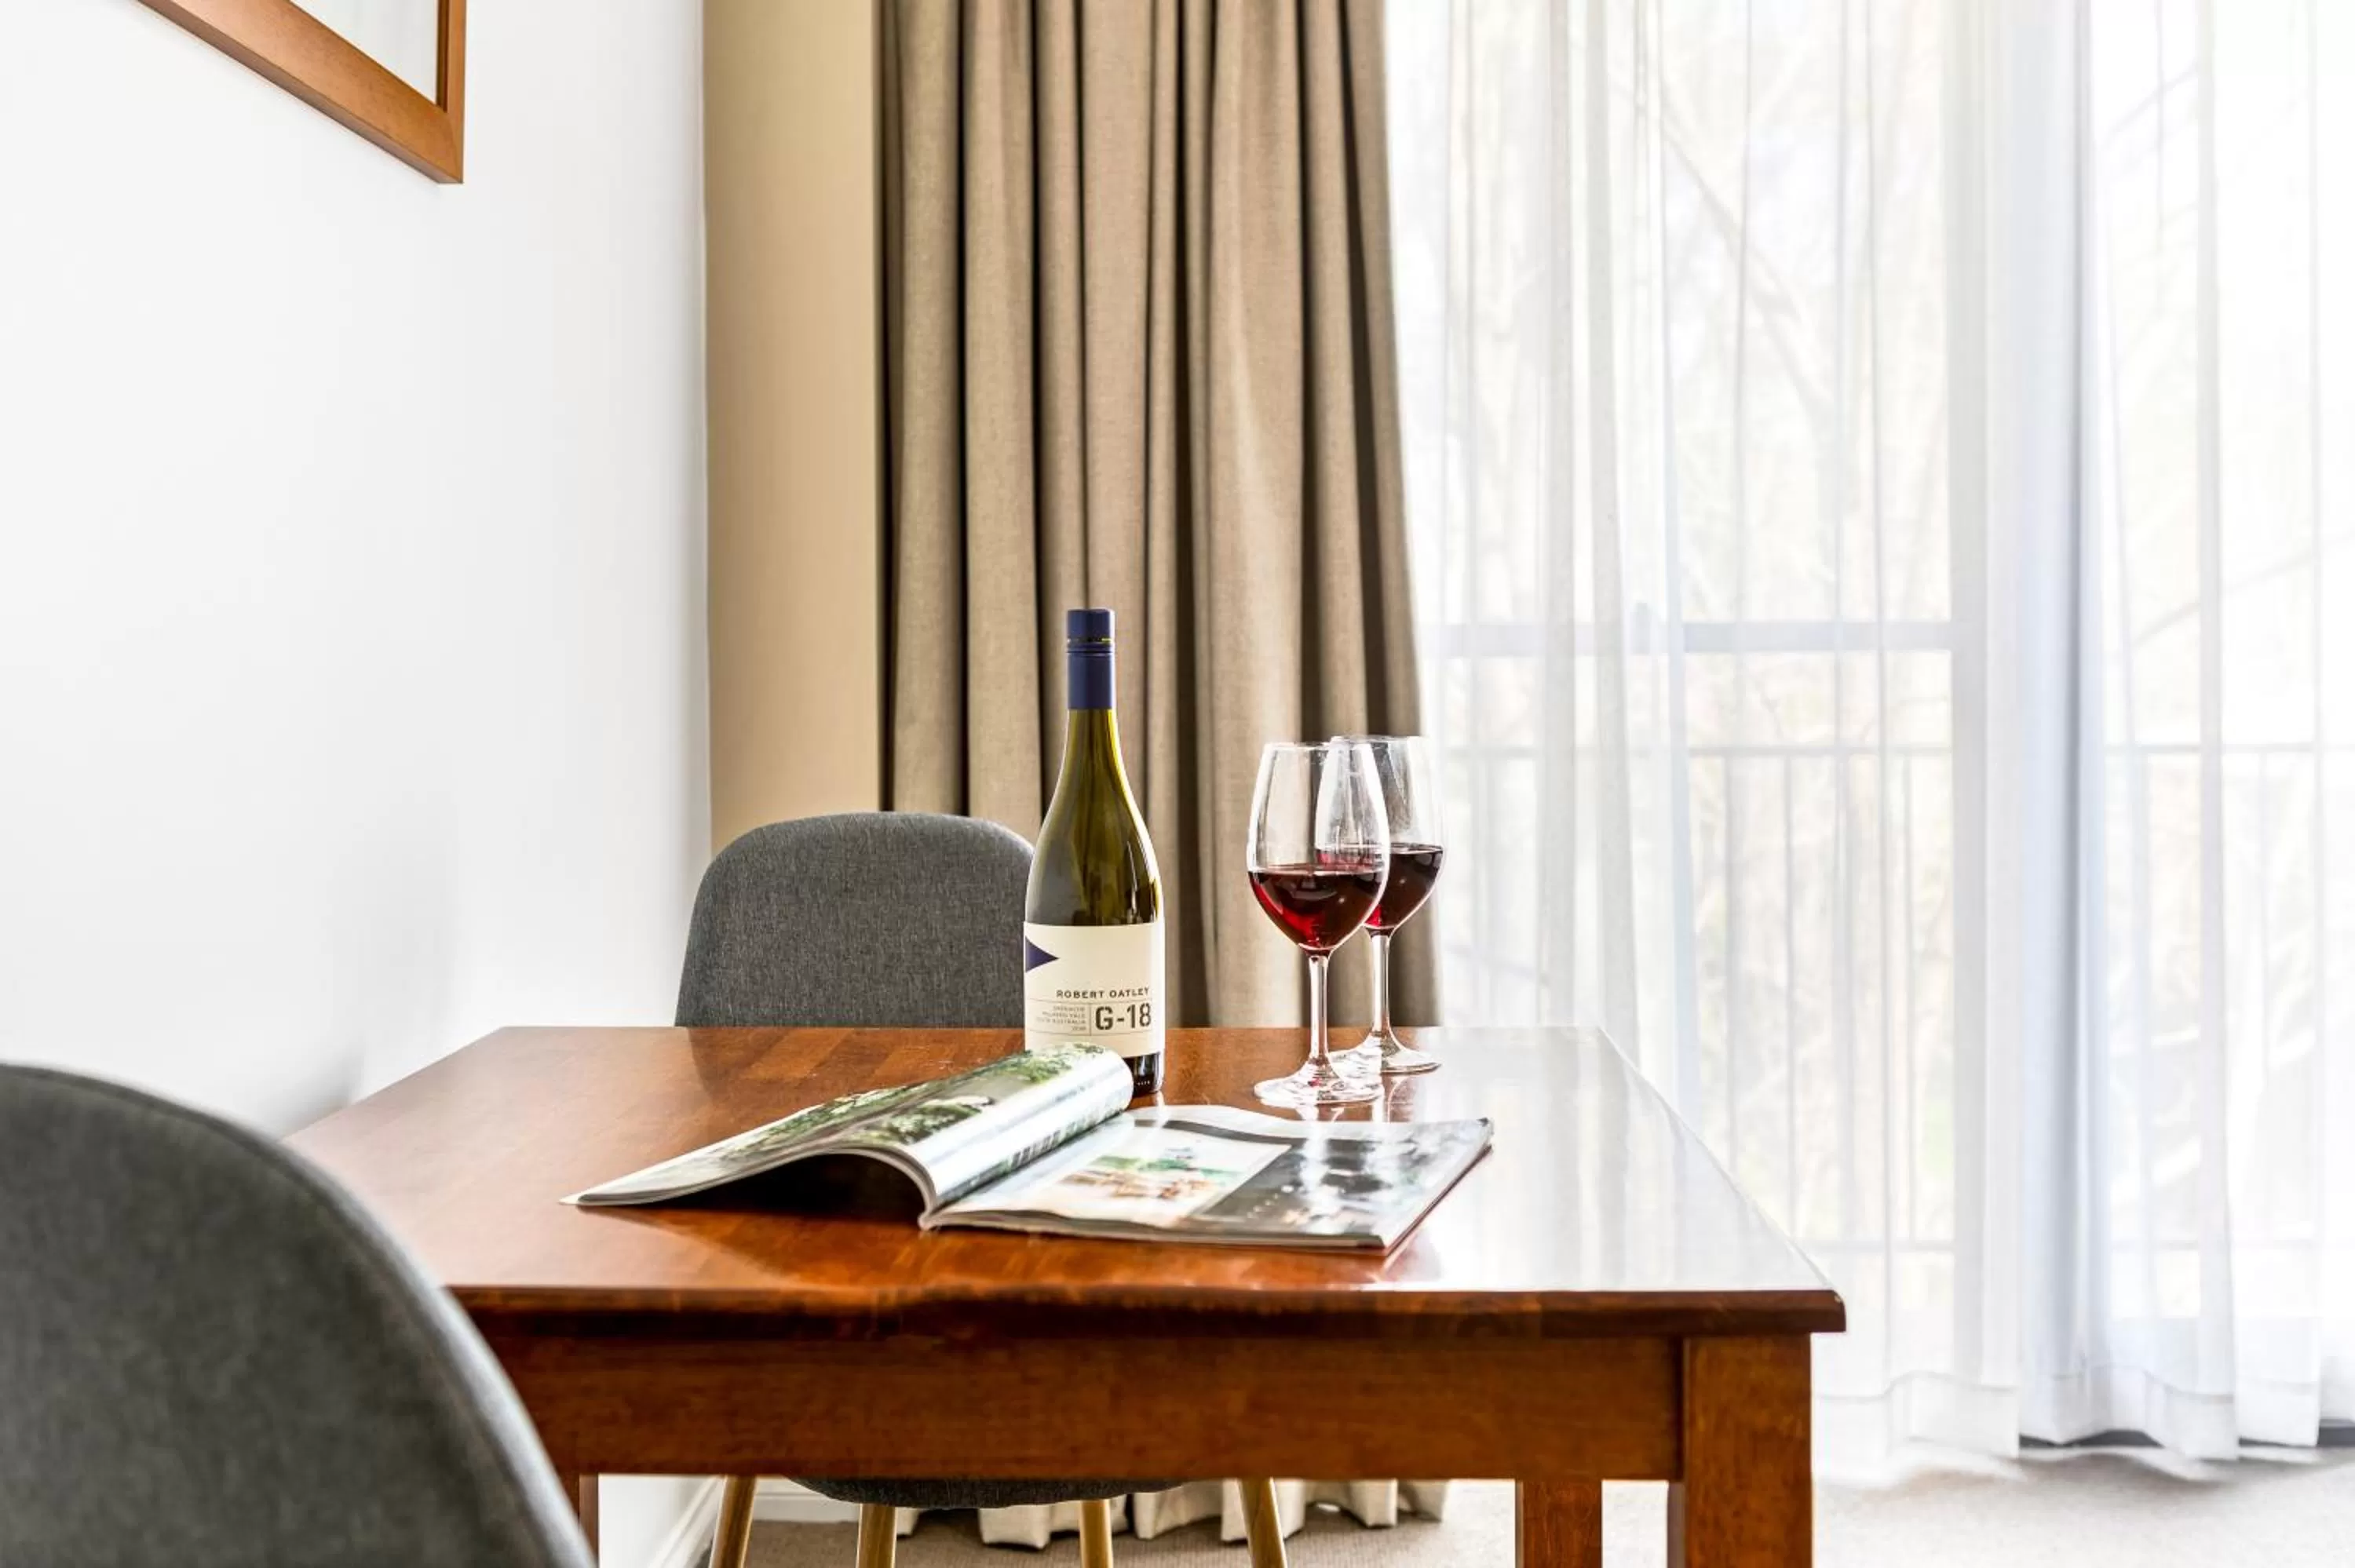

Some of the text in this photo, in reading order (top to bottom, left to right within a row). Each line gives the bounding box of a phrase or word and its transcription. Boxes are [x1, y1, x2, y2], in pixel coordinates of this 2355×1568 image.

[1056, 986, 1149, 999] ROBERT OATLEY
[1095, 1002, 1152, 1030] G-18
